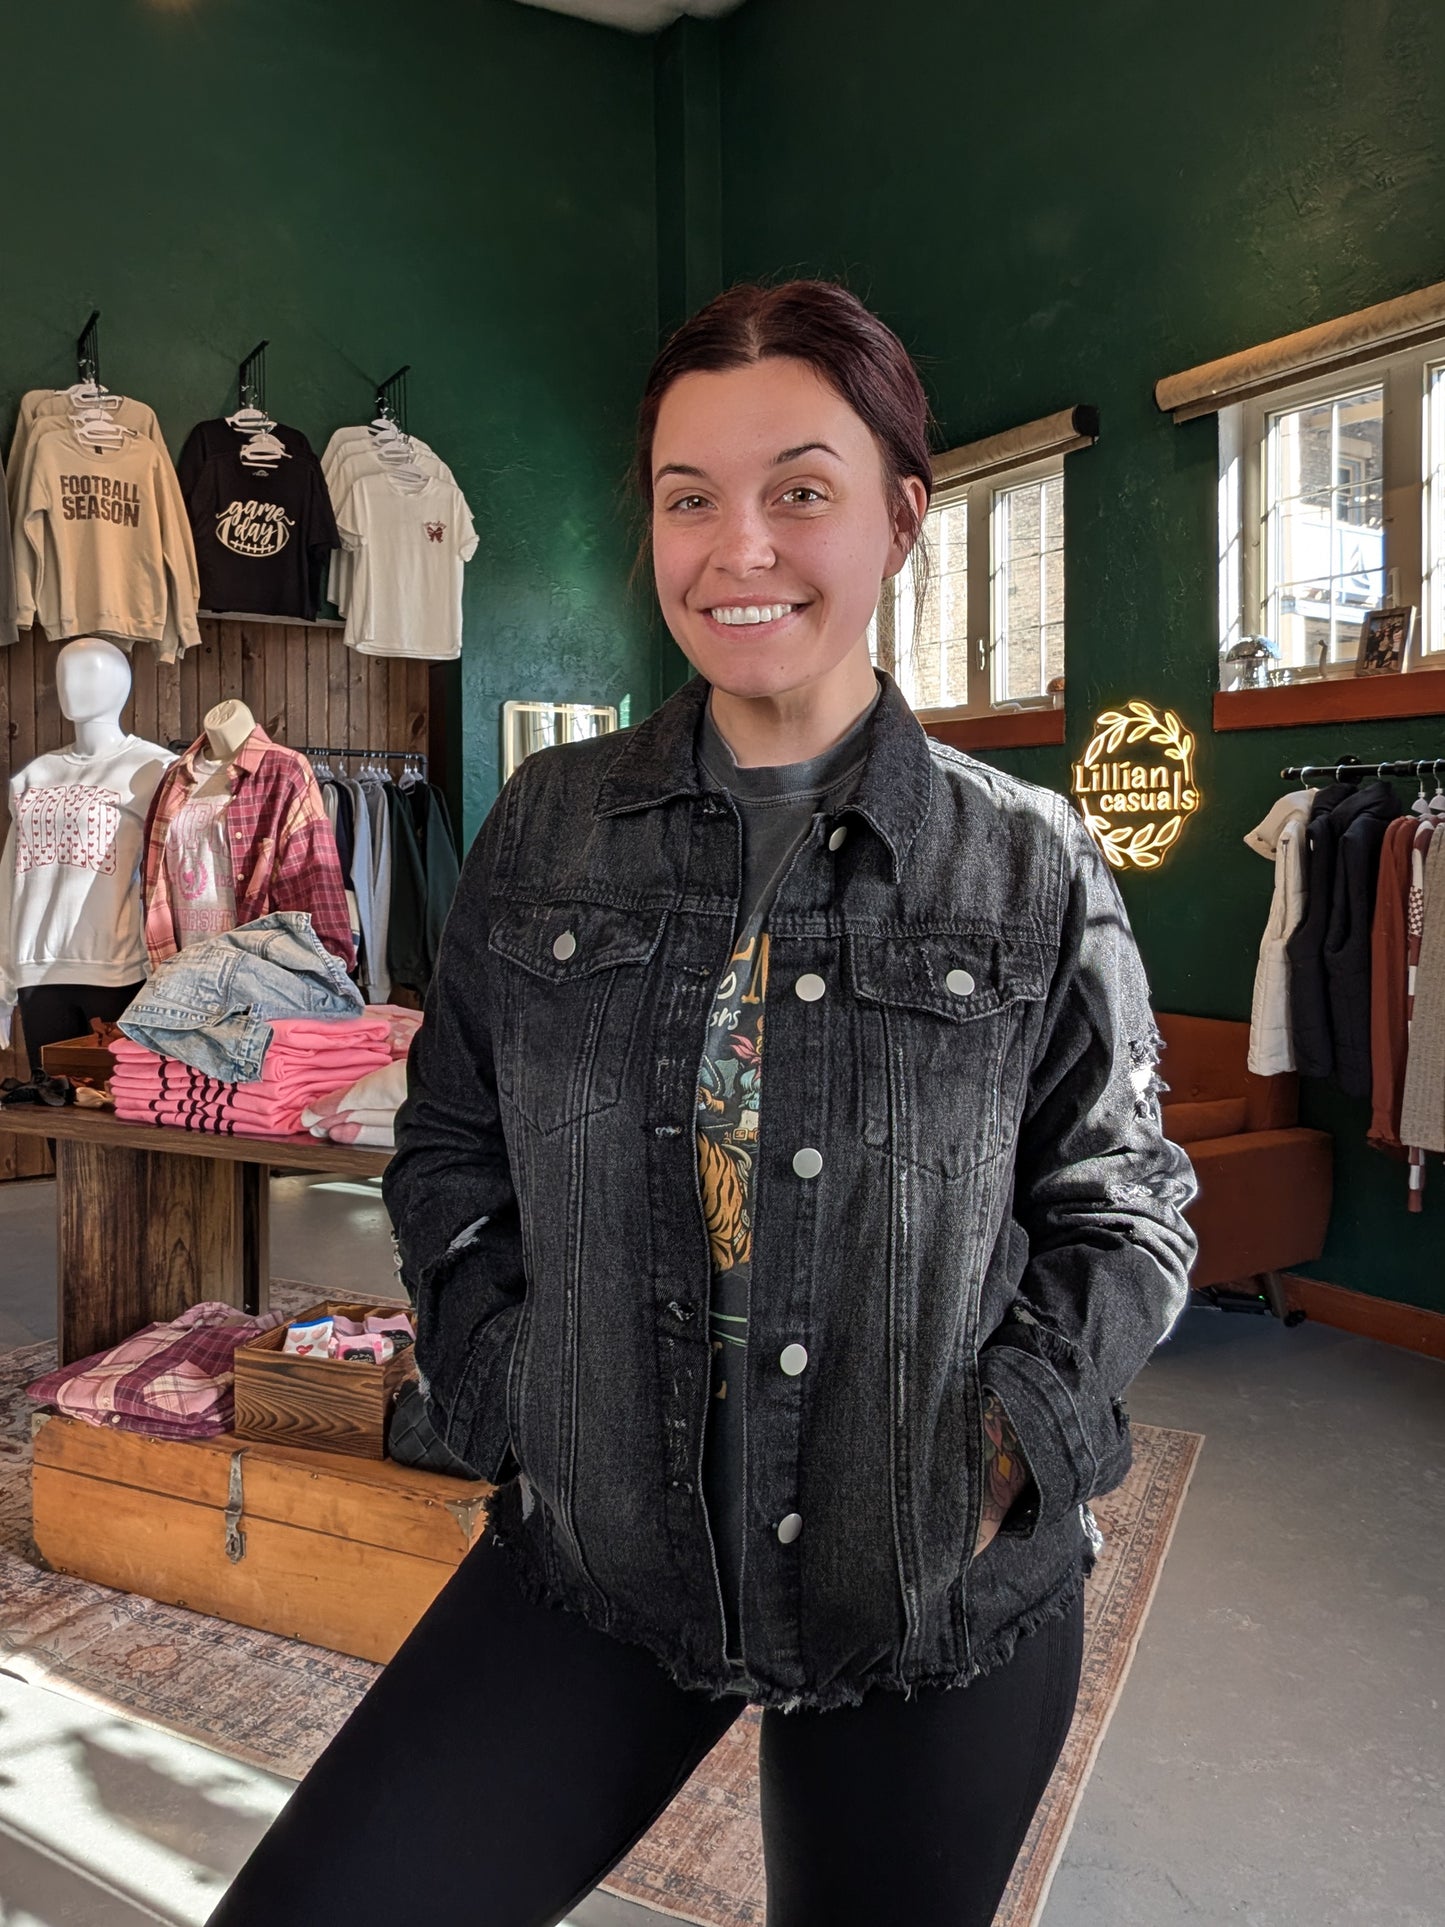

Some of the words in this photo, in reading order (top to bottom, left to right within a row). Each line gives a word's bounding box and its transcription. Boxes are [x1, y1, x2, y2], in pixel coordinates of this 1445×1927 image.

[60, 475, 140, 503] FOOTBALL
[62, 495, 140, 528] SEASON
[216, 500, 295, 526] game
[234, 517, 277, 545] day
[1075, 761, 1169, 793] Lillian
[1100, 771, 1197, 813] casuals
